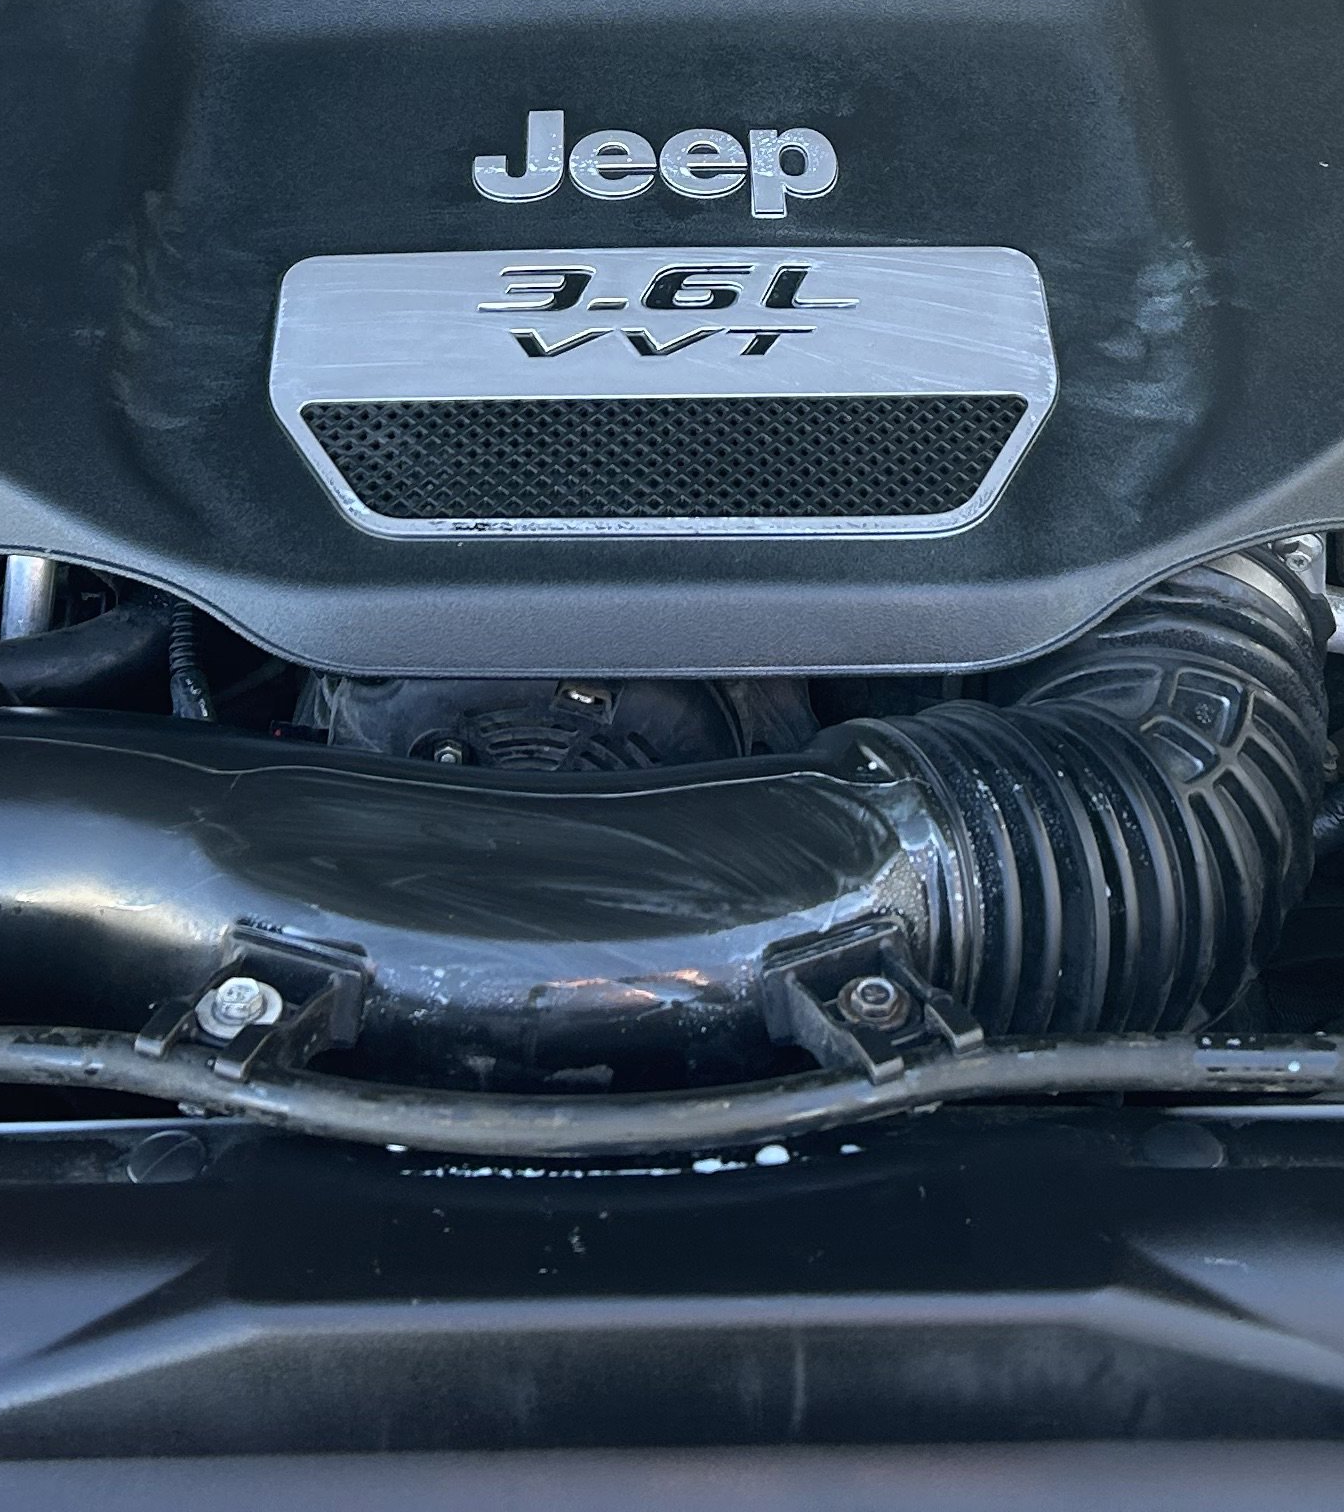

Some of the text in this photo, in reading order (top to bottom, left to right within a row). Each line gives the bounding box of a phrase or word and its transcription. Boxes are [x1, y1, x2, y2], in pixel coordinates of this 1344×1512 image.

[472, 109, 839, 219] Jeep
[477, 263, 860, 312] 3.6L
[509, 326, 817, 357] VVT
